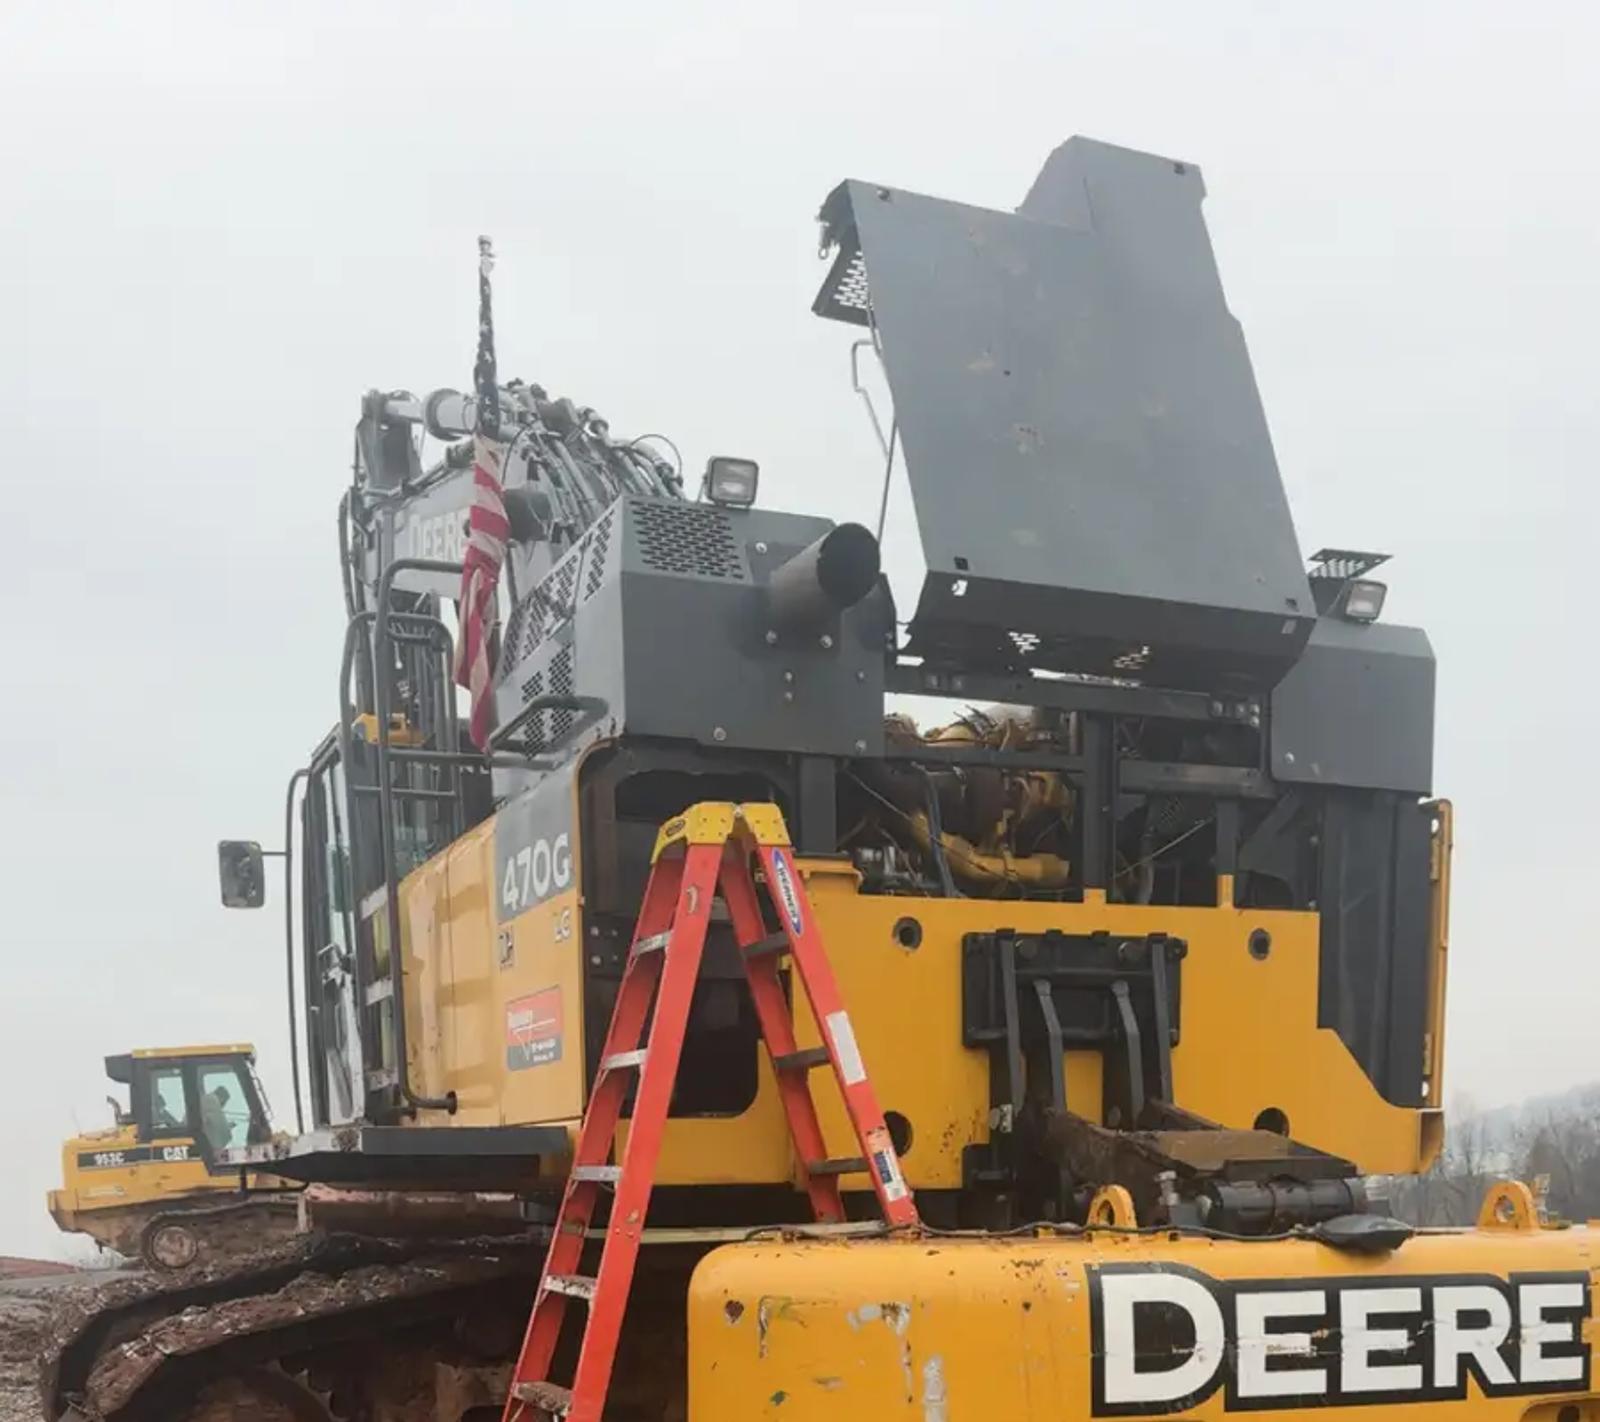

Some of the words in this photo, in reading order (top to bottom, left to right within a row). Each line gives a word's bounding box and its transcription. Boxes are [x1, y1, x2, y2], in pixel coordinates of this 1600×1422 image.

[503, 832, 571, 911] 470G
[162, 1146, 190, 1161] CAT
[1101, 1273, 1584, 1404] DEERE
